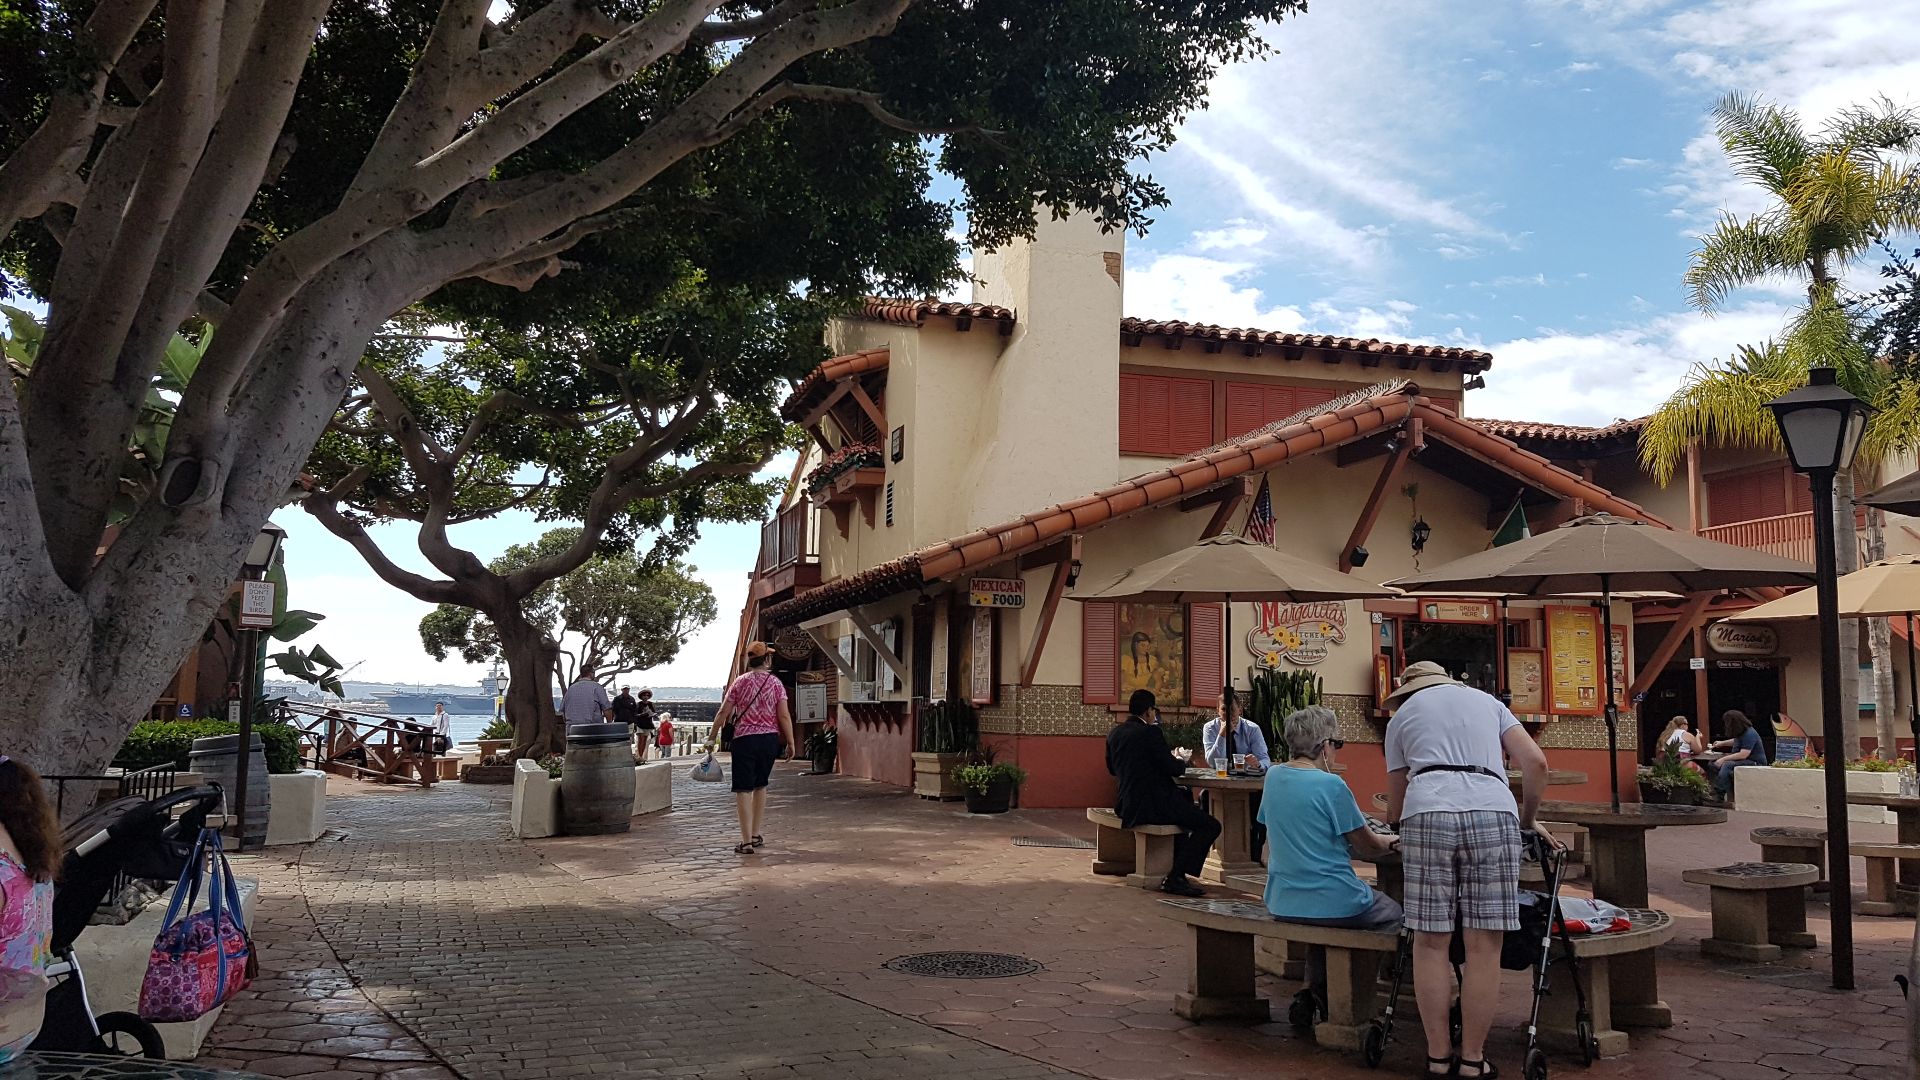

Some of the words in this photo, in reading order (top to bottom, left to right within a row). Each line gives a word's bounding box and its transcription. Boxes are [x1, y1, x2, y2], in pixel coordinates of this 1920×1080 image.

[972, 580, 1022, 592] MEXICAN
[992, 593, 1022, 605] FOOD
[1381, 624, 1388, 637] A
